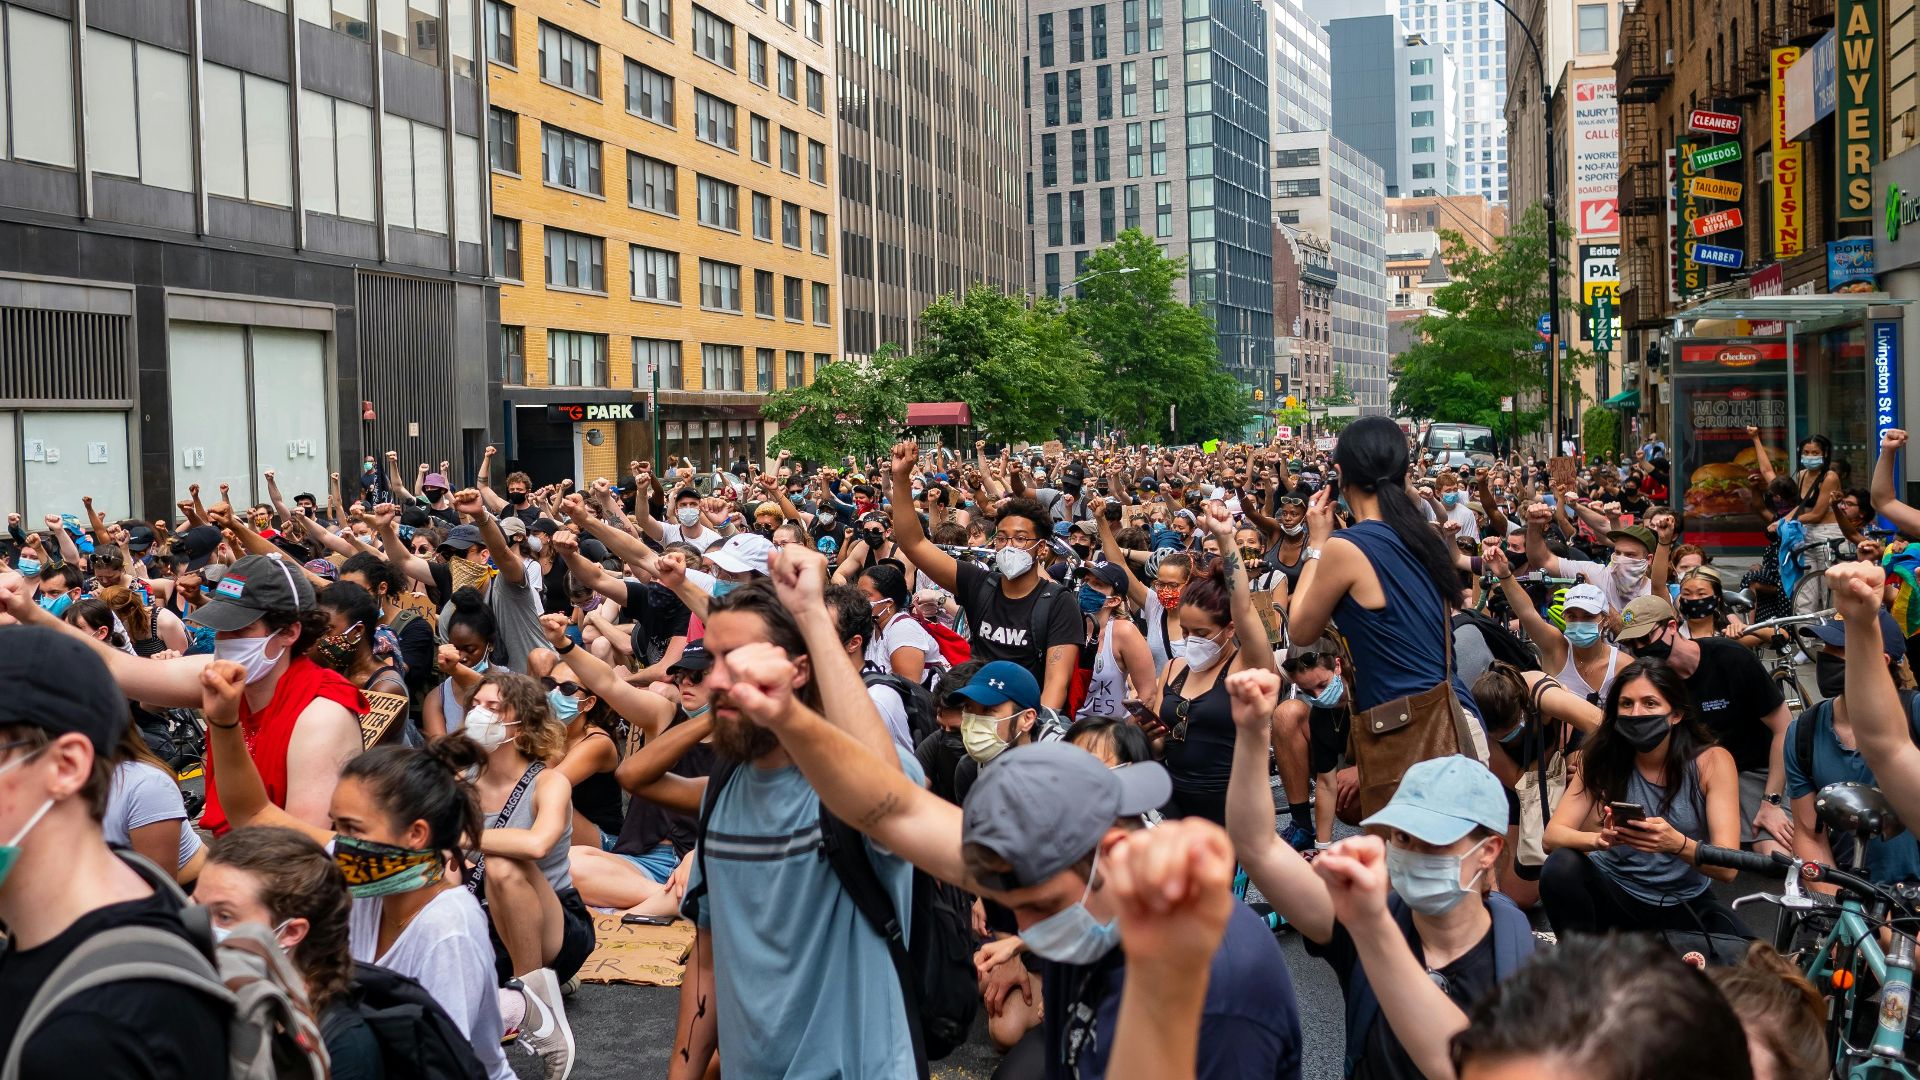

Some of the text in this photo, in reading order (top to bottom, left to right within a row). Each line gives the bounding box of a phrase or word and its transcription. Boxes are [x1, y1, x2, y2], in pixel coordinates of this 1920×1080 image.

[1577, 108, 1608, 118] INJURY
[1694, 115, 1736, 130] CLEANERS
[1585, 130, 1609, 140] CALL
[1585, 151, 1618, 160] WORKE
[1696, 147, 1737, 164] TUXEDOS
[1696, 182, 1738, 196] TAILORING
[1778, 159, 1798, 255] CUISINE
[1702, 219, 1734, 234] REPAIR
[1704, 212, 1728, 226] SHOE
[1590, 247, 1620, 256] Ediso
[1701, 249, 1734, 264] BARBER
[1835, 244, 1870, 254] POKE
[1597, 297, 1609, 350] PIZZA
[1720, 352, 1757, 361] Checkers
[1875, 327, 1890, 394] Livingston
[586, 404, 634, 420] PARK
[1694, 400, 1785, 416] MOTHER
[1878, 397, 1892, 412] St
[1694, 415, 1785, 428] CRUNCHER
[1879, 415, 1892, 425] &
[979, 620, 1028, 646] RAW.
[503, 787, 524, 816] BAGGU
[521, 761, 545, 784] BAGG
